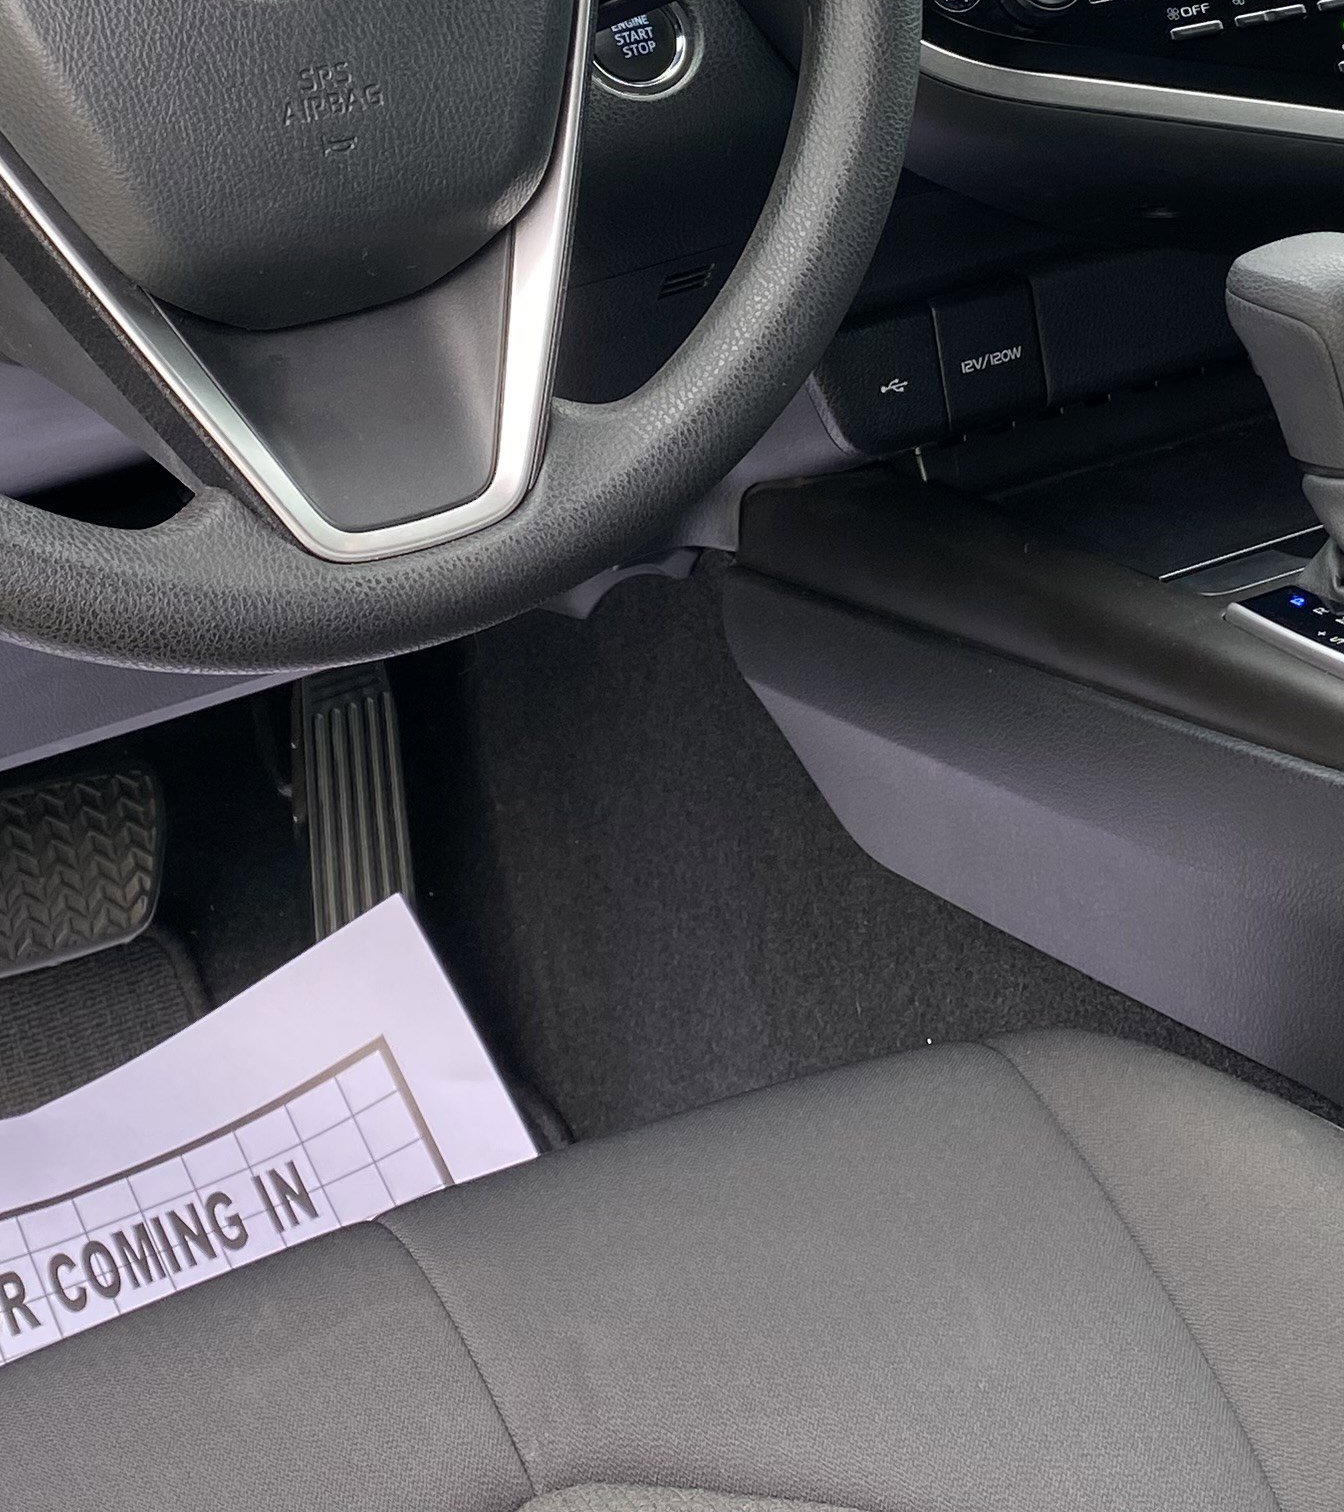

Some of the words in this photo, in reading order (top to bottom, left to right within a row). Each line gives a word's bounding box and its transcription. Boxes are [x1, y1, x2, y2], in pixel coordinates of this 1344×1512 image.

[1180, 2, 1211, 18] OFF
[611, 14, 649, 32] ENGINE
[614, 26, 653, 46] START
[622, 40, 656, 59] STOP
[961, 345, 1022, 374] 12V/120W
[47, 1191, 249, 1313] COMING
[251, 1160, 319, 1233] IN
